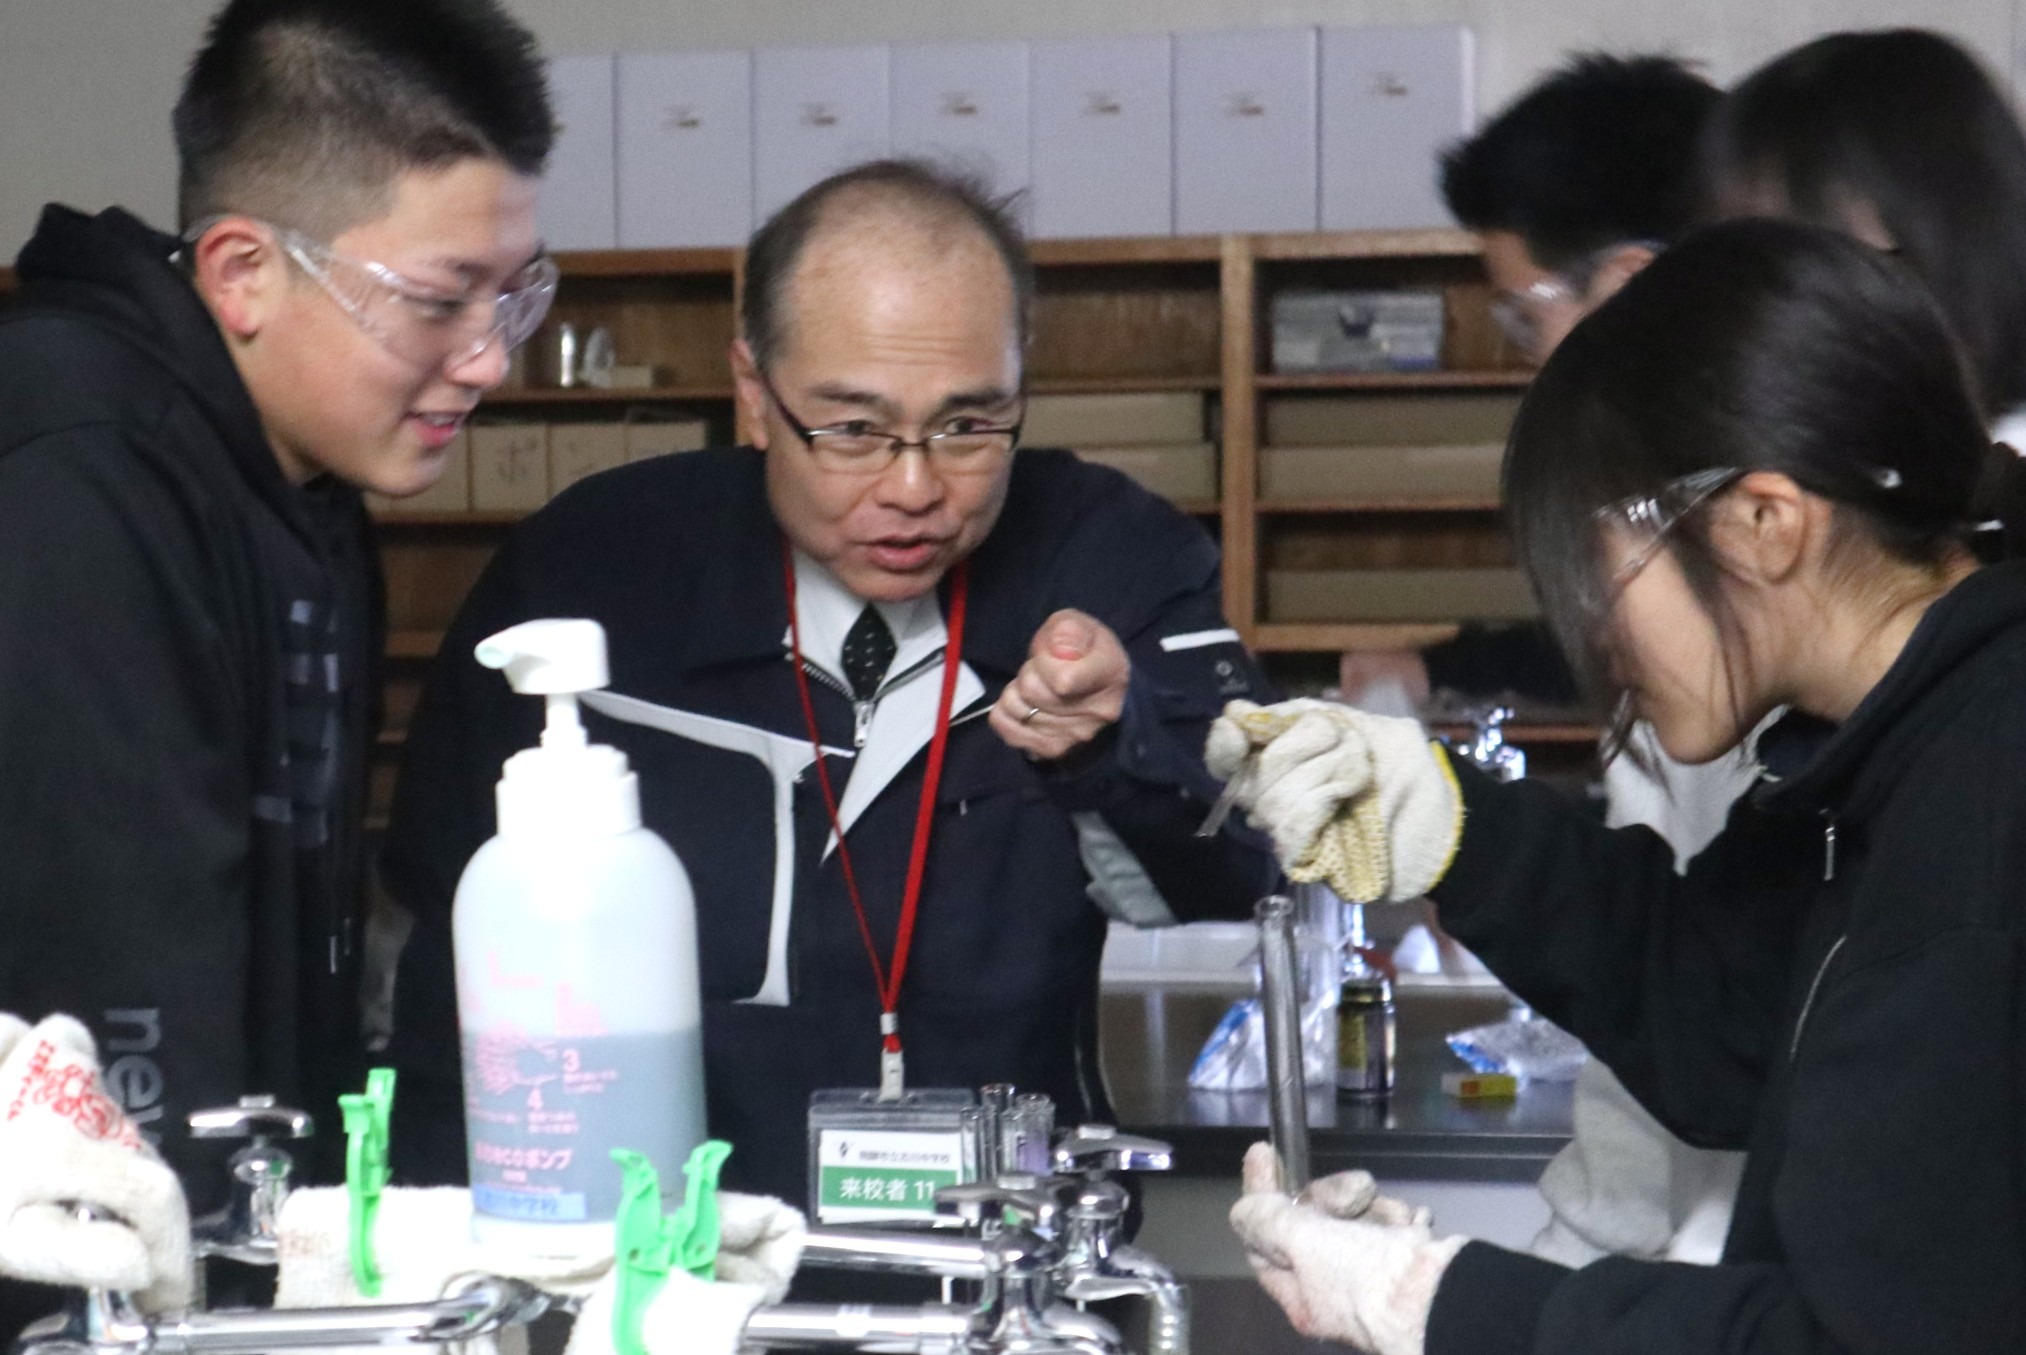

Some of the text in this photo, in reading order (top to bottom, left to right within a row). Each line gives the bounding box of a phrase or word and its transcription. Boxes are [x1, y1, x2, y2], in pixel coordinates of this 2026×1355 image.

[563, 1049, 580, 1073] 3
[527, 1087, 543, 1111] 4
[840, 1176, 935, 1202] 来校者 11
